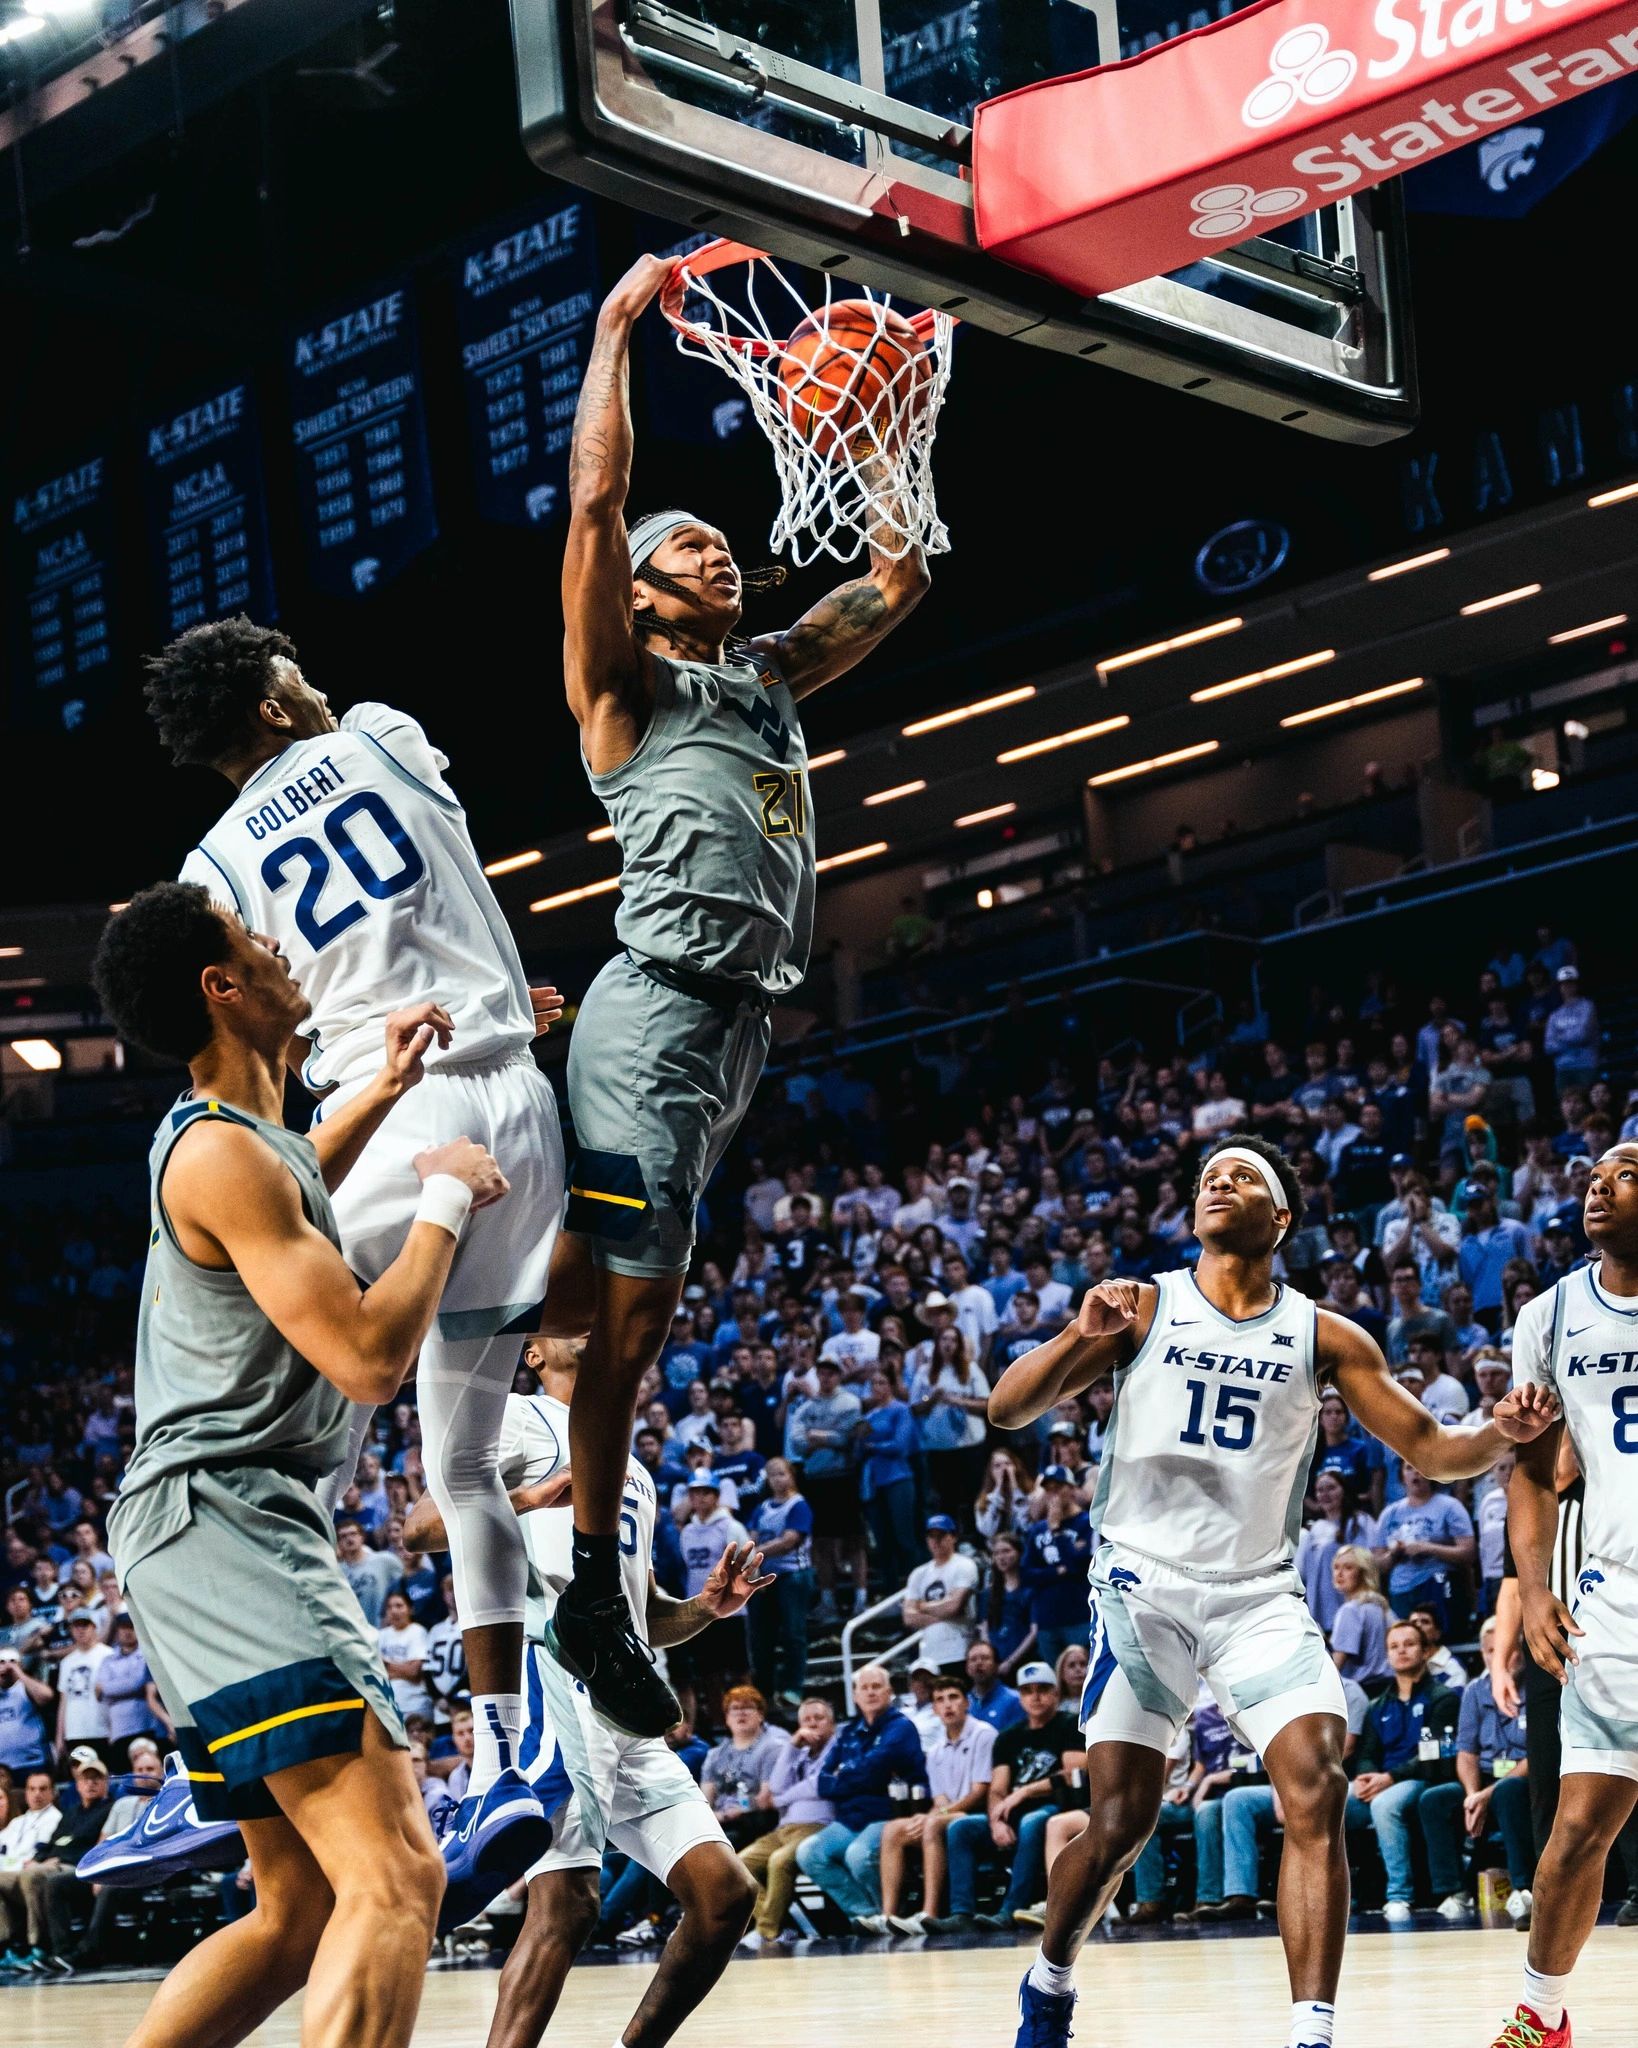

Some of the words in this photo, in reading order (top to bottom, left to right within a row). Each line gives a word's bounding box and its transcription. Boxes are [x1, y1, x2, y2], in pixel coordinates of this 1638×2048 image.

[462, 202, 582, 288] K-STATE
[294, 290, 404, 367] K-STATE
[461, 323, 520, 372] SWEET
[521, 287, 593, 341] SIXTEEN
[147, 384, 246, 456] K-STATE
[245, 755, 345, 840] COLBERT
[752, 770, 805, 837] 21
[261, 791, 426, 953] 20
[1163, 1345, 1293, 1383] K-STATE
[1180, 1379, 1262, 1451] 15
